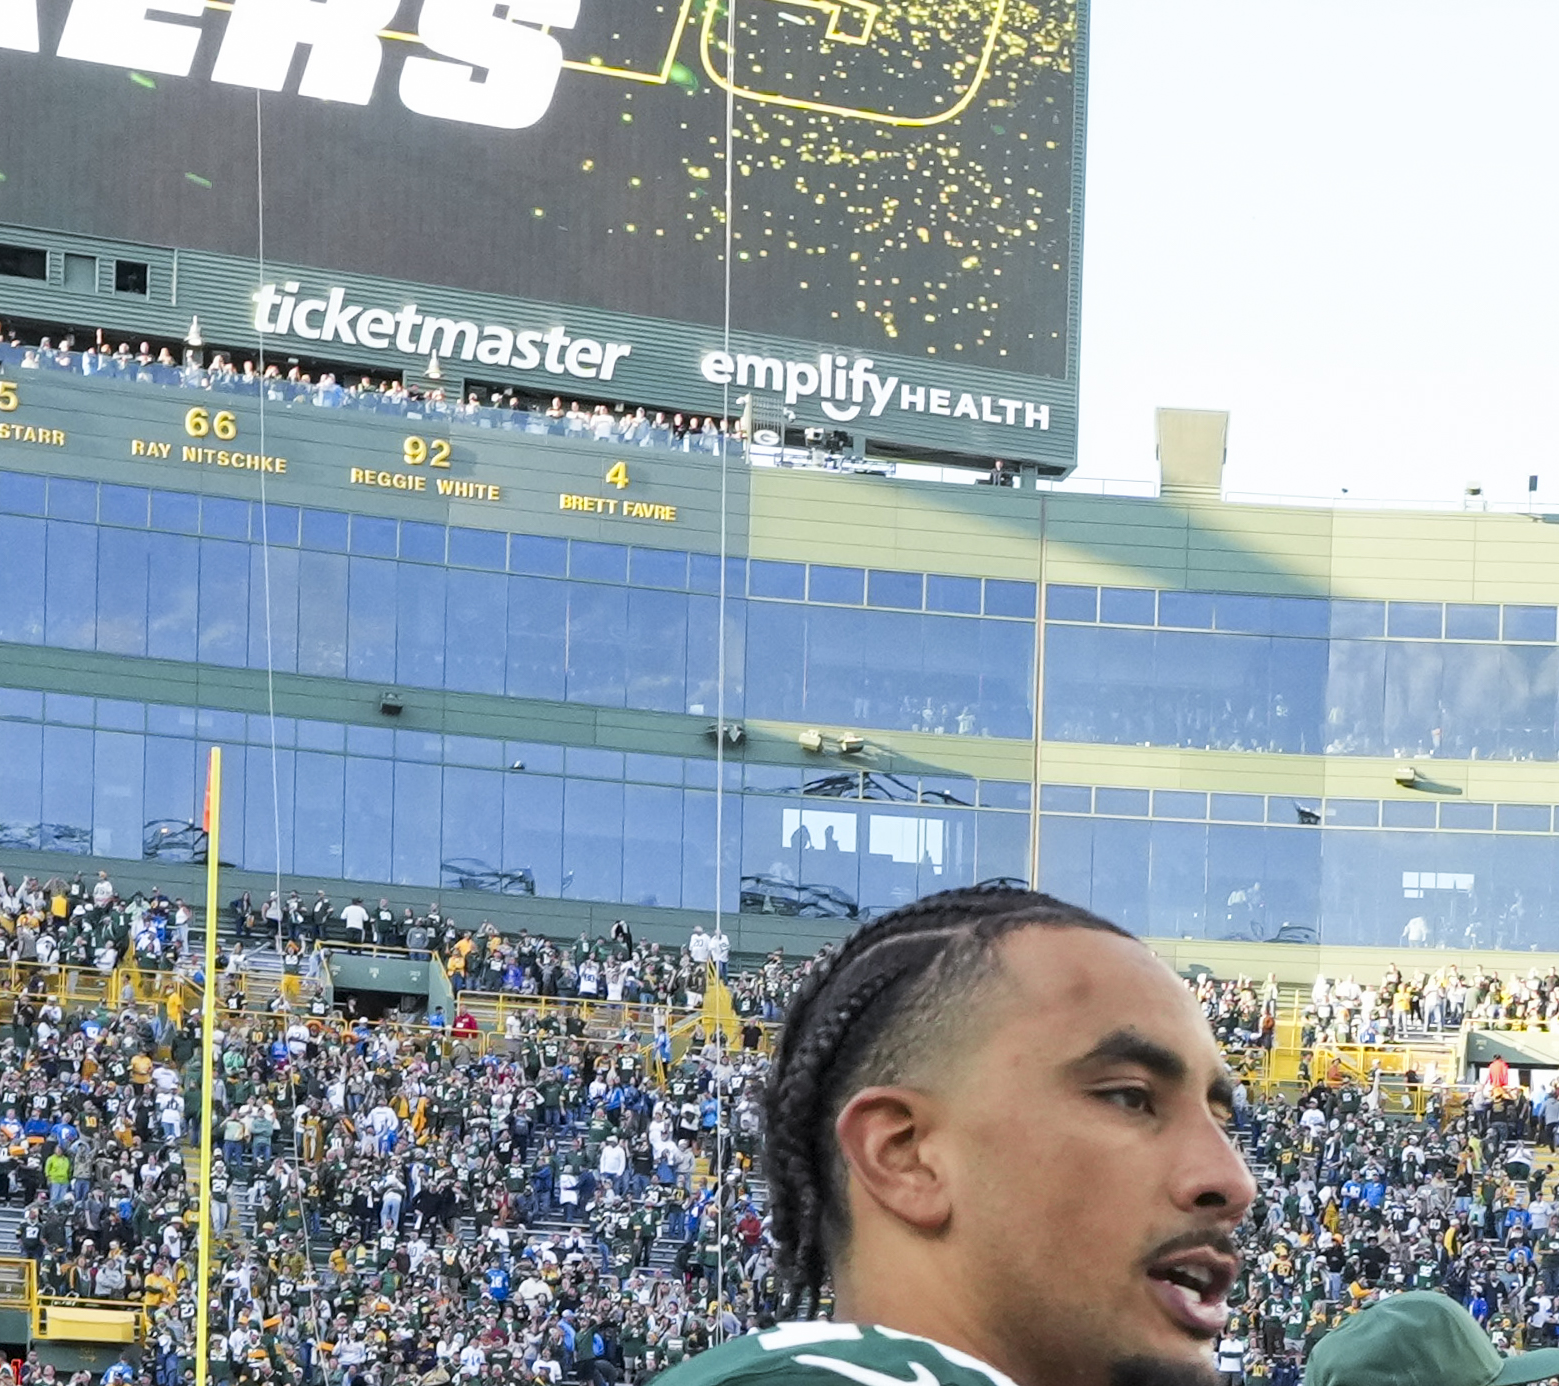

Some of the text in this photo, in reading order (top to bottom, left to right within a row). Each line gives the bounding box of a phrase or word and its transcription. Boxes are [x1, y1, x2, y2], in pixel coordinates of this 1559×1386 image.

[254, 282, 631, 381] ticketmaster
[702, 350, 1050, 430] emplify HEALTH
[185, 407, 237, 441] 66
[131, 439, 288, 474] RAY NITSCHKE
[403, 436, 451, 468] 92
[350, 467, 500, 501] REGGIE WHITE
[606, 460, 629, 490] 4
[559, 493, 677, 522] BRETT FAVRE
